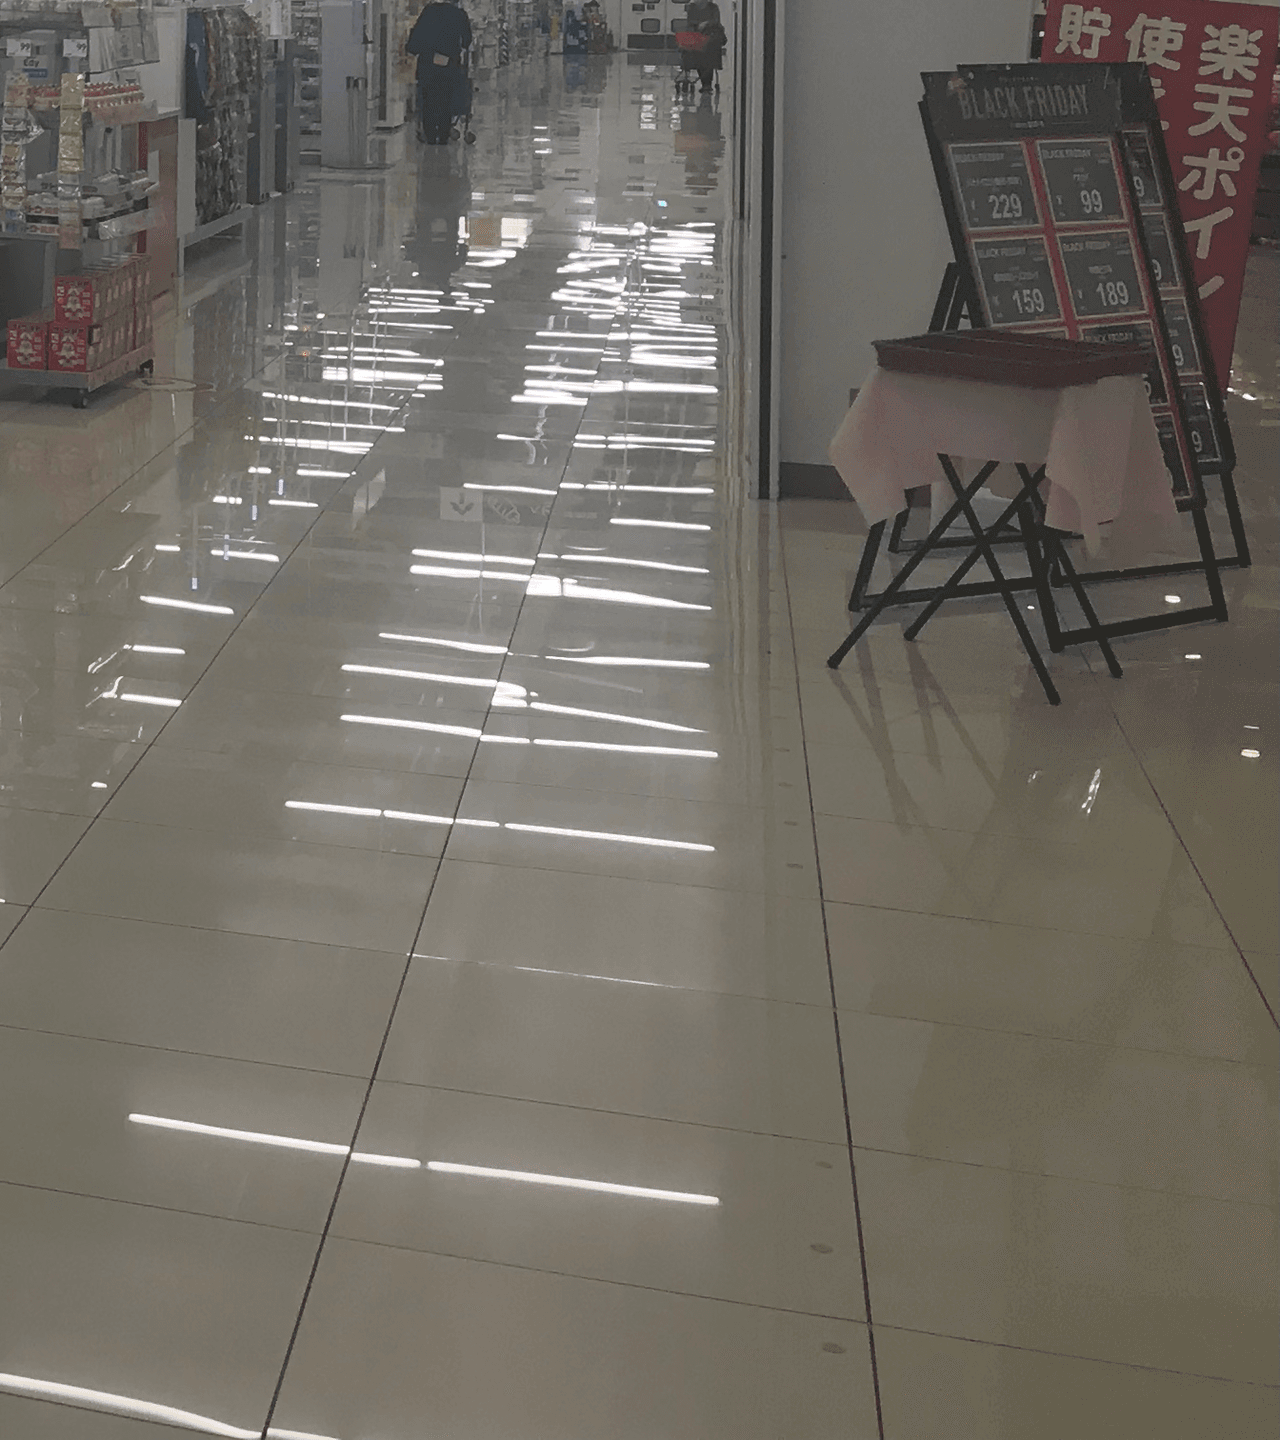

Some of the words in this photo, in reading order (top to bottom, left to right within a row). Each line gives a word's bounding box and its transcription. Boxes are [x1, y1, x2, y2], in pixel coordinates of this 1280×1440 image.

[1054, 2, 1112, 60] 貯
[957, 86, 1022, 120] BLACK
[1022, 84, 1089, 119] FRIDAY
[988, 192, 1023, 219] 229
[1080, 189, 1103, 214] 99
[1011, 288, 1045, 314] 159
[1095, 281, 1129, 307] 189
